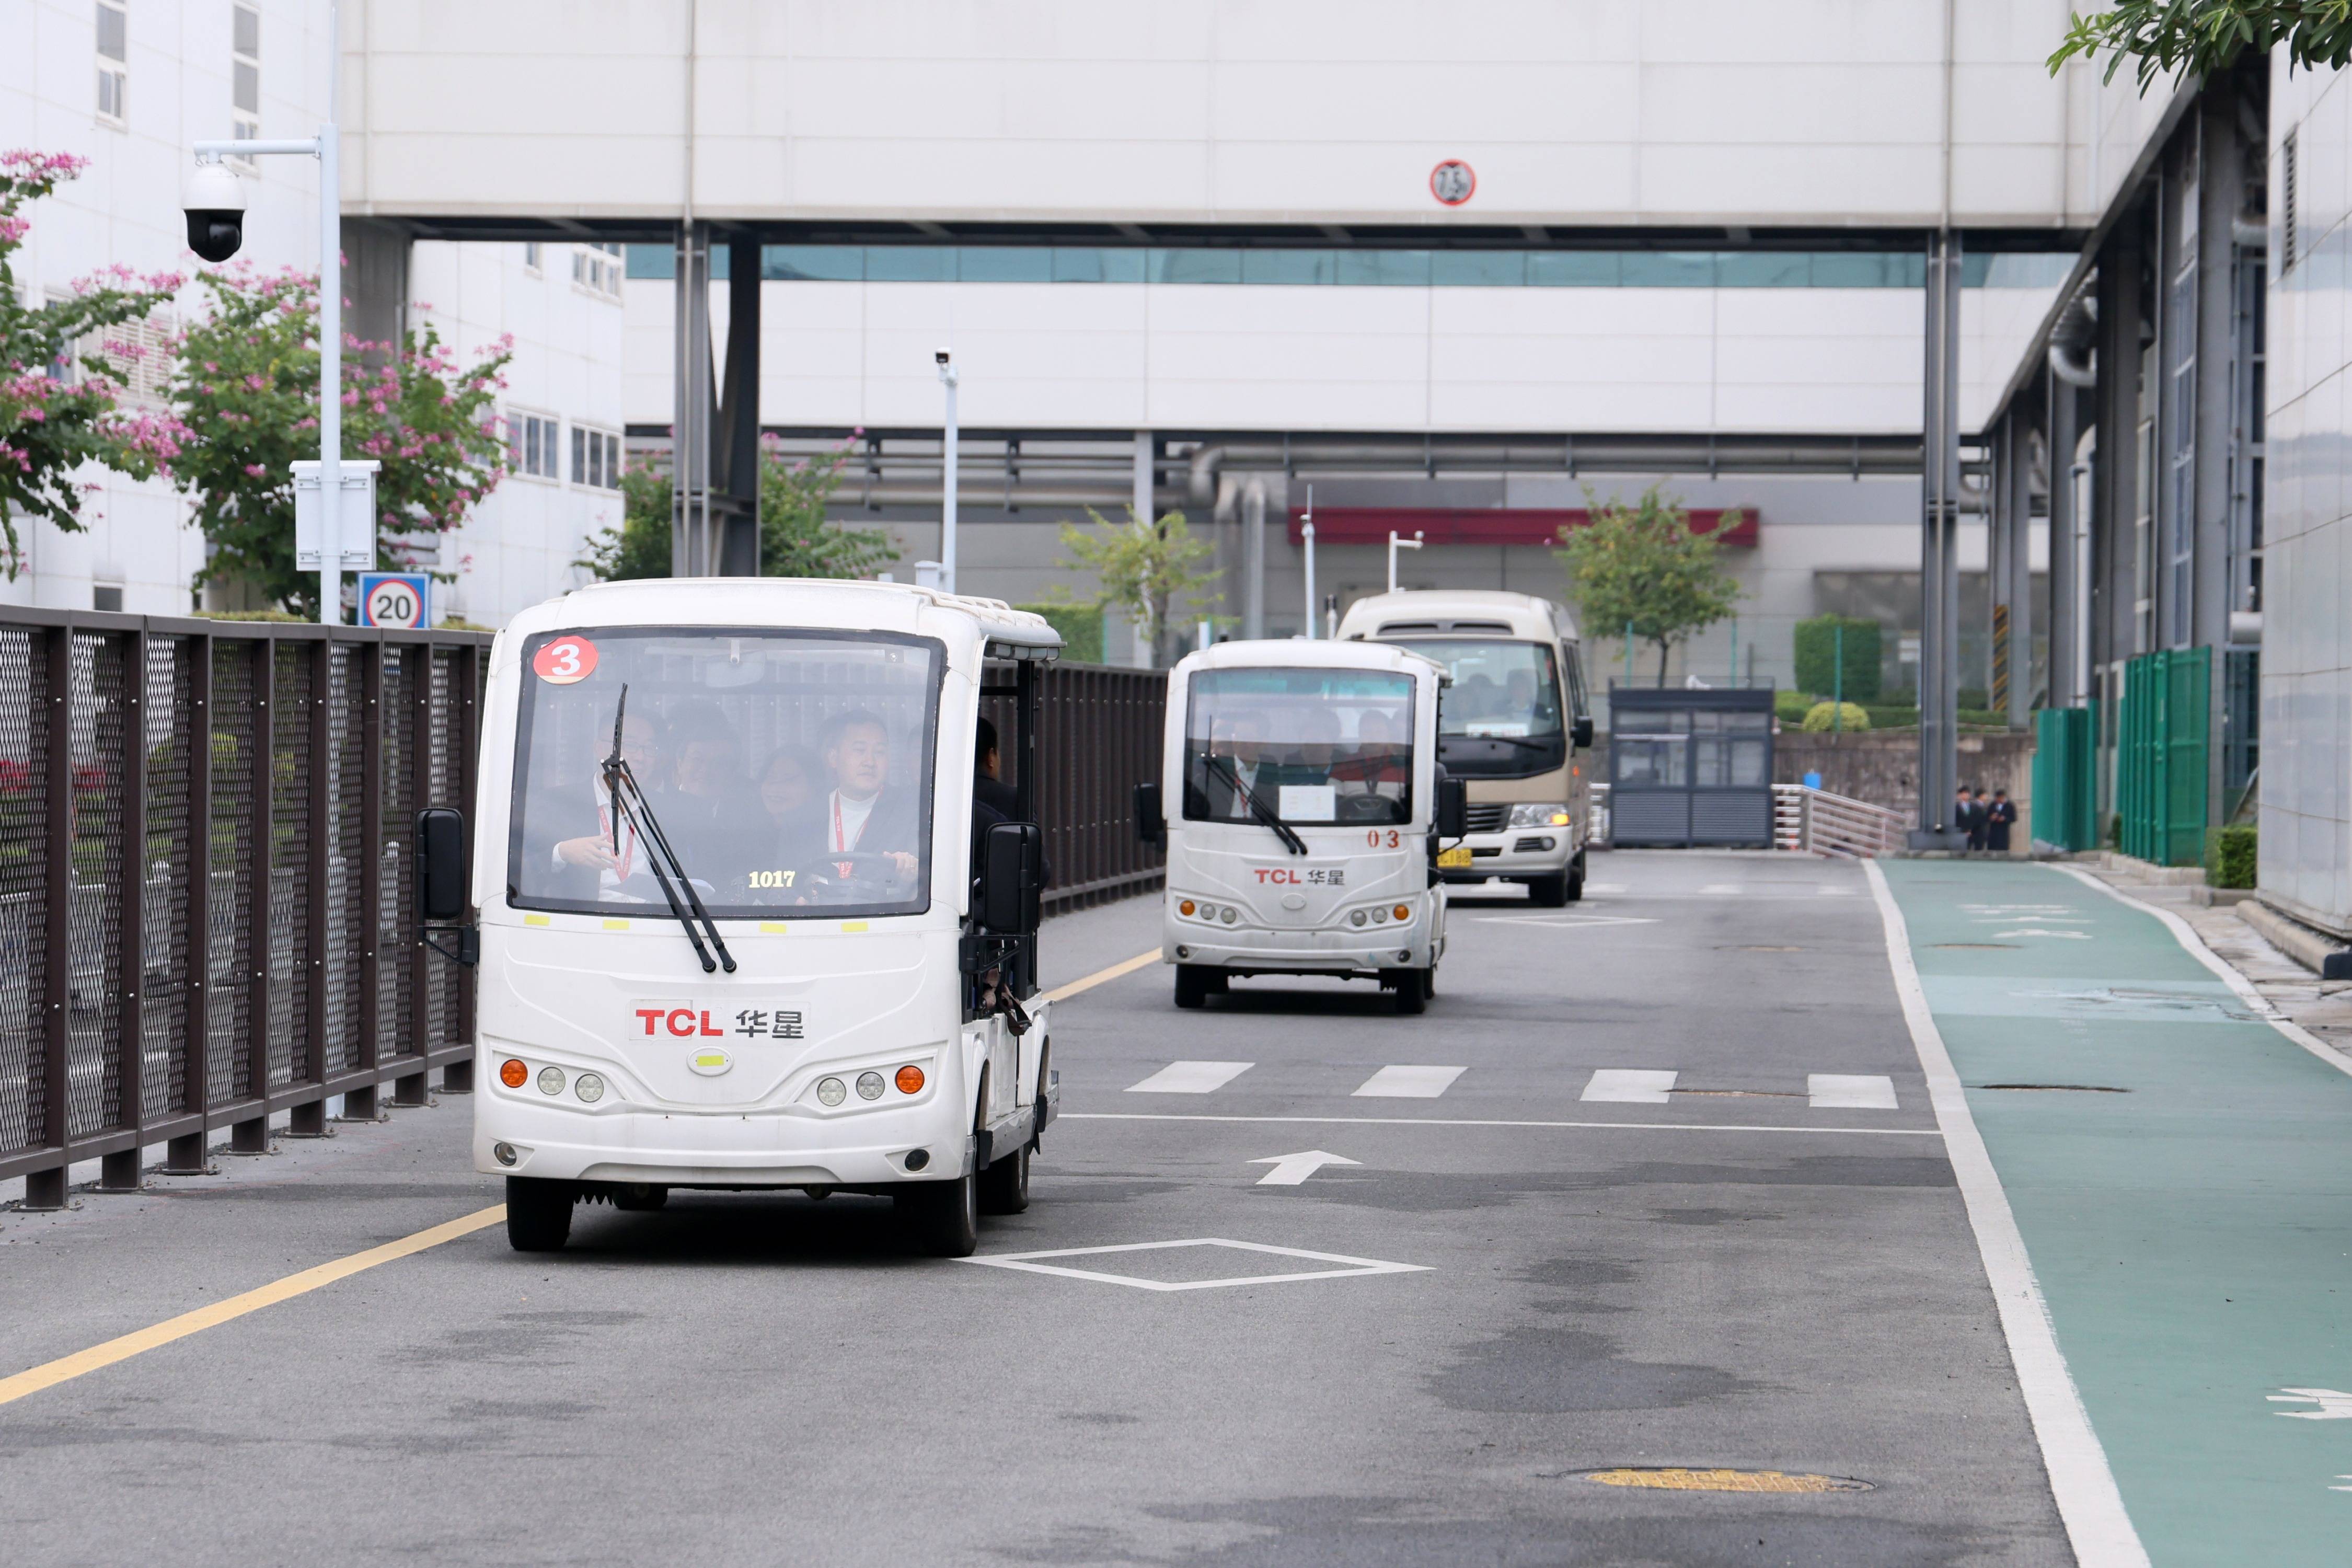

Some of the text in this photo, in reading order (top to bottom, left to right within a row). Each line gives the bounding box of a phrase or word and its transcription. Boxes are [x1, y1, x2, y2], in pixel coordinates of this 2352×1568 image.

[377, 595, 411, 620] 20
[551, 644, 580, 676] 3
[749, 870, 795, 888] 1017
[1254, 869, 1345, 885] TCL 华星
[636, 1009, 804, 1039] TCL 华星
